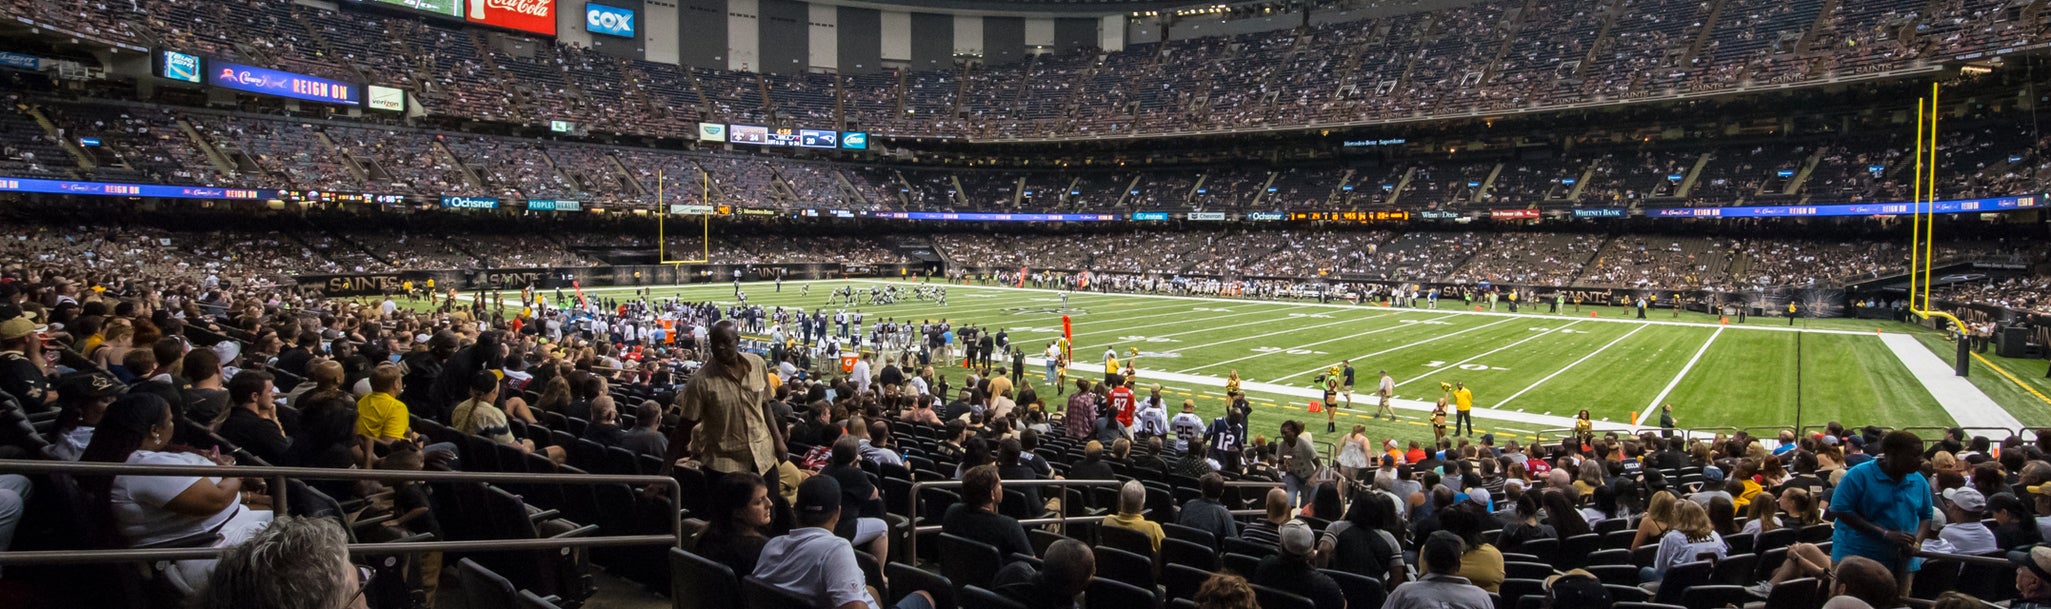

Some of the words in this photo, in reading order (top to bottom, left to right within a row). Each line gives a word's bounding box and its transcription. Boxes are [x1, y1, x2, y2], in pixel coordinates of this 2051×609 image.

[588, 10, 633, 32] COX
[172, 52, 194, 63] BUD
[293, 79, 328, 97] REIGN
[331, 84, 348, 100] ON
[372, 99, 400, 107] verizon
[749, 134, 759, 142] 24
[806, 137, 816, 145] 20
[225, 189, 246, 198] REIGN
[247, 190, 258, 199] ON
[451, 197, 495, 209] Ochsner
[529, 201, 555, 209] PEOPLES
[1252, 212, 1281, 220] Ochsner
[1789, 207, 1807, 215] REIGN
[845, 358, 852, 367] G
[1146, 420, 1154, 435] 9
[1176, 425, 1193, 440] 25
[1216, 432, 1235, 451] 12
